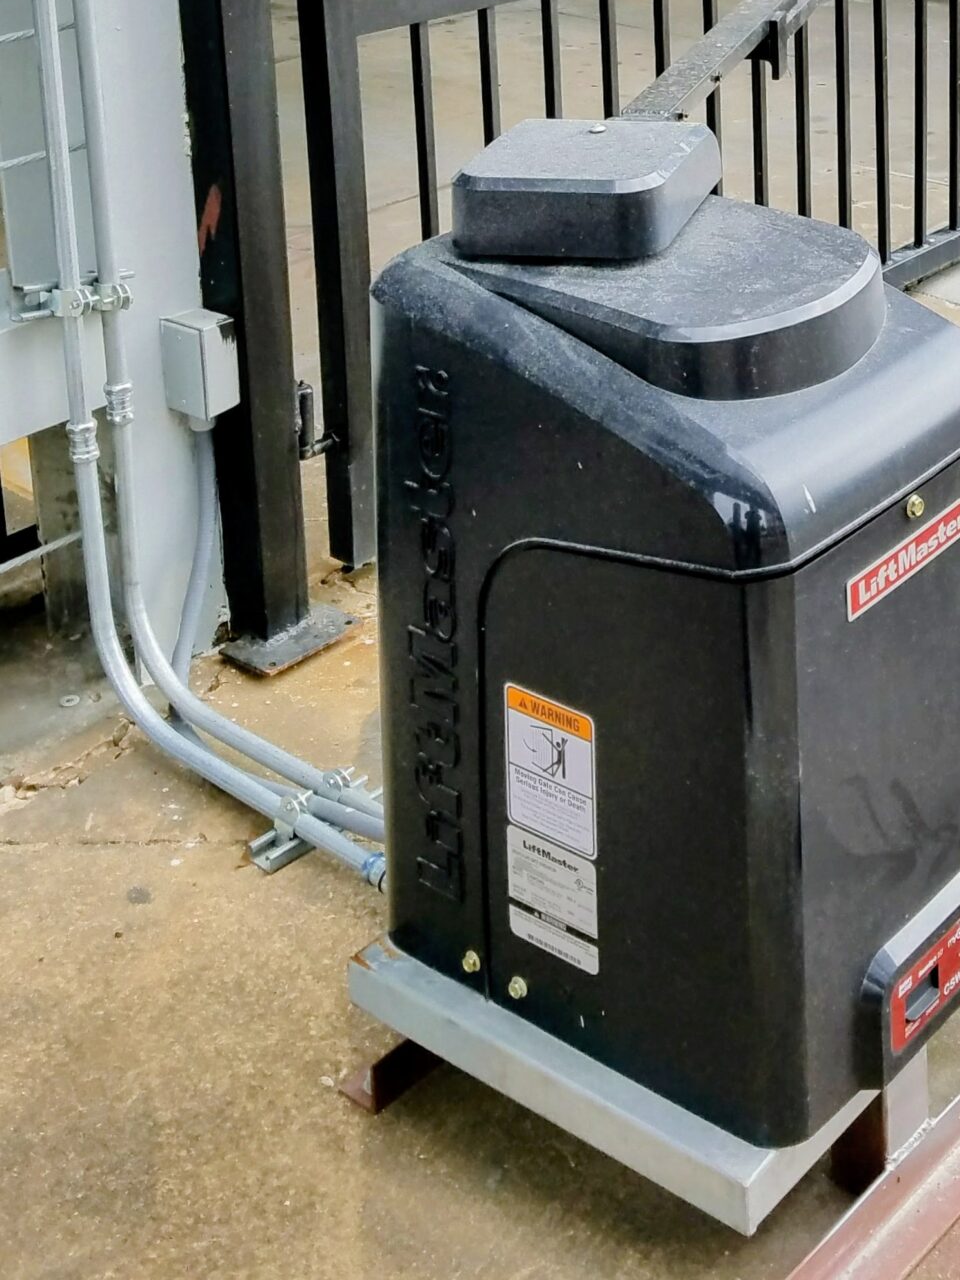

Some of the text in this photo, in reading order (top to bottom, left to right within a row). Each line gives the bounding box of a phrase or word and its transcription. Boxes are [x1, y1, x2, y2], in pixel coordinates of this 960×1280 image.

[529, 699, 580, 733] WARNING
[514, 767, 587, 806] Moving Gate Can Cause
[515, 775, 539, 792] Serious
[540, 787, 558, 801] Injury
[567, 798, 586, 813] Death
[522, 839, 579, 873] LiftMaster
